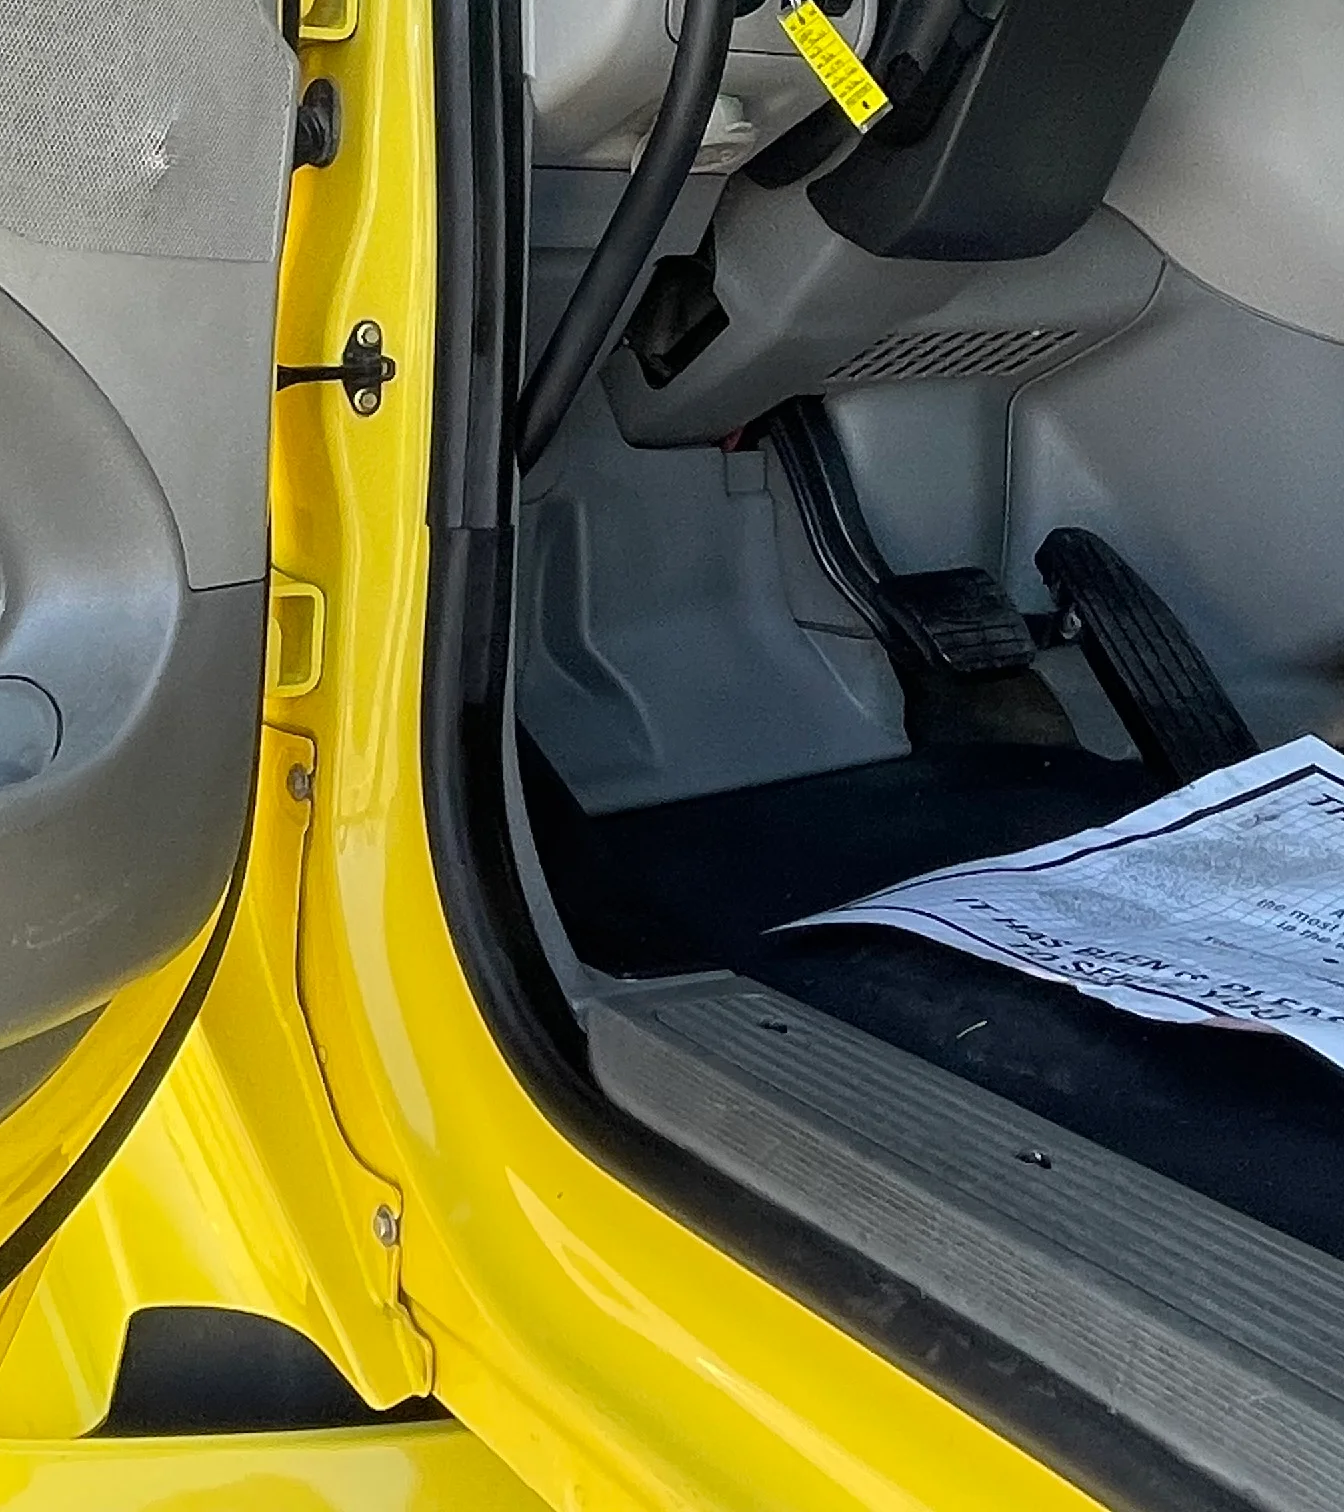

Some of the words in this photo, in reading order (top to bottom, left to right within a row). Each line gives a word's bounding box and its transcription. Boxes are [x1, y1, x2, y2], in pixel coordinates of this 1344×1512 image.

[953, 898, 1001, 913] IT
[992, 917, 1073, 948] HAS
[1256, 898, 1287, 912] the
[1289, 909, 1340, 933] most
